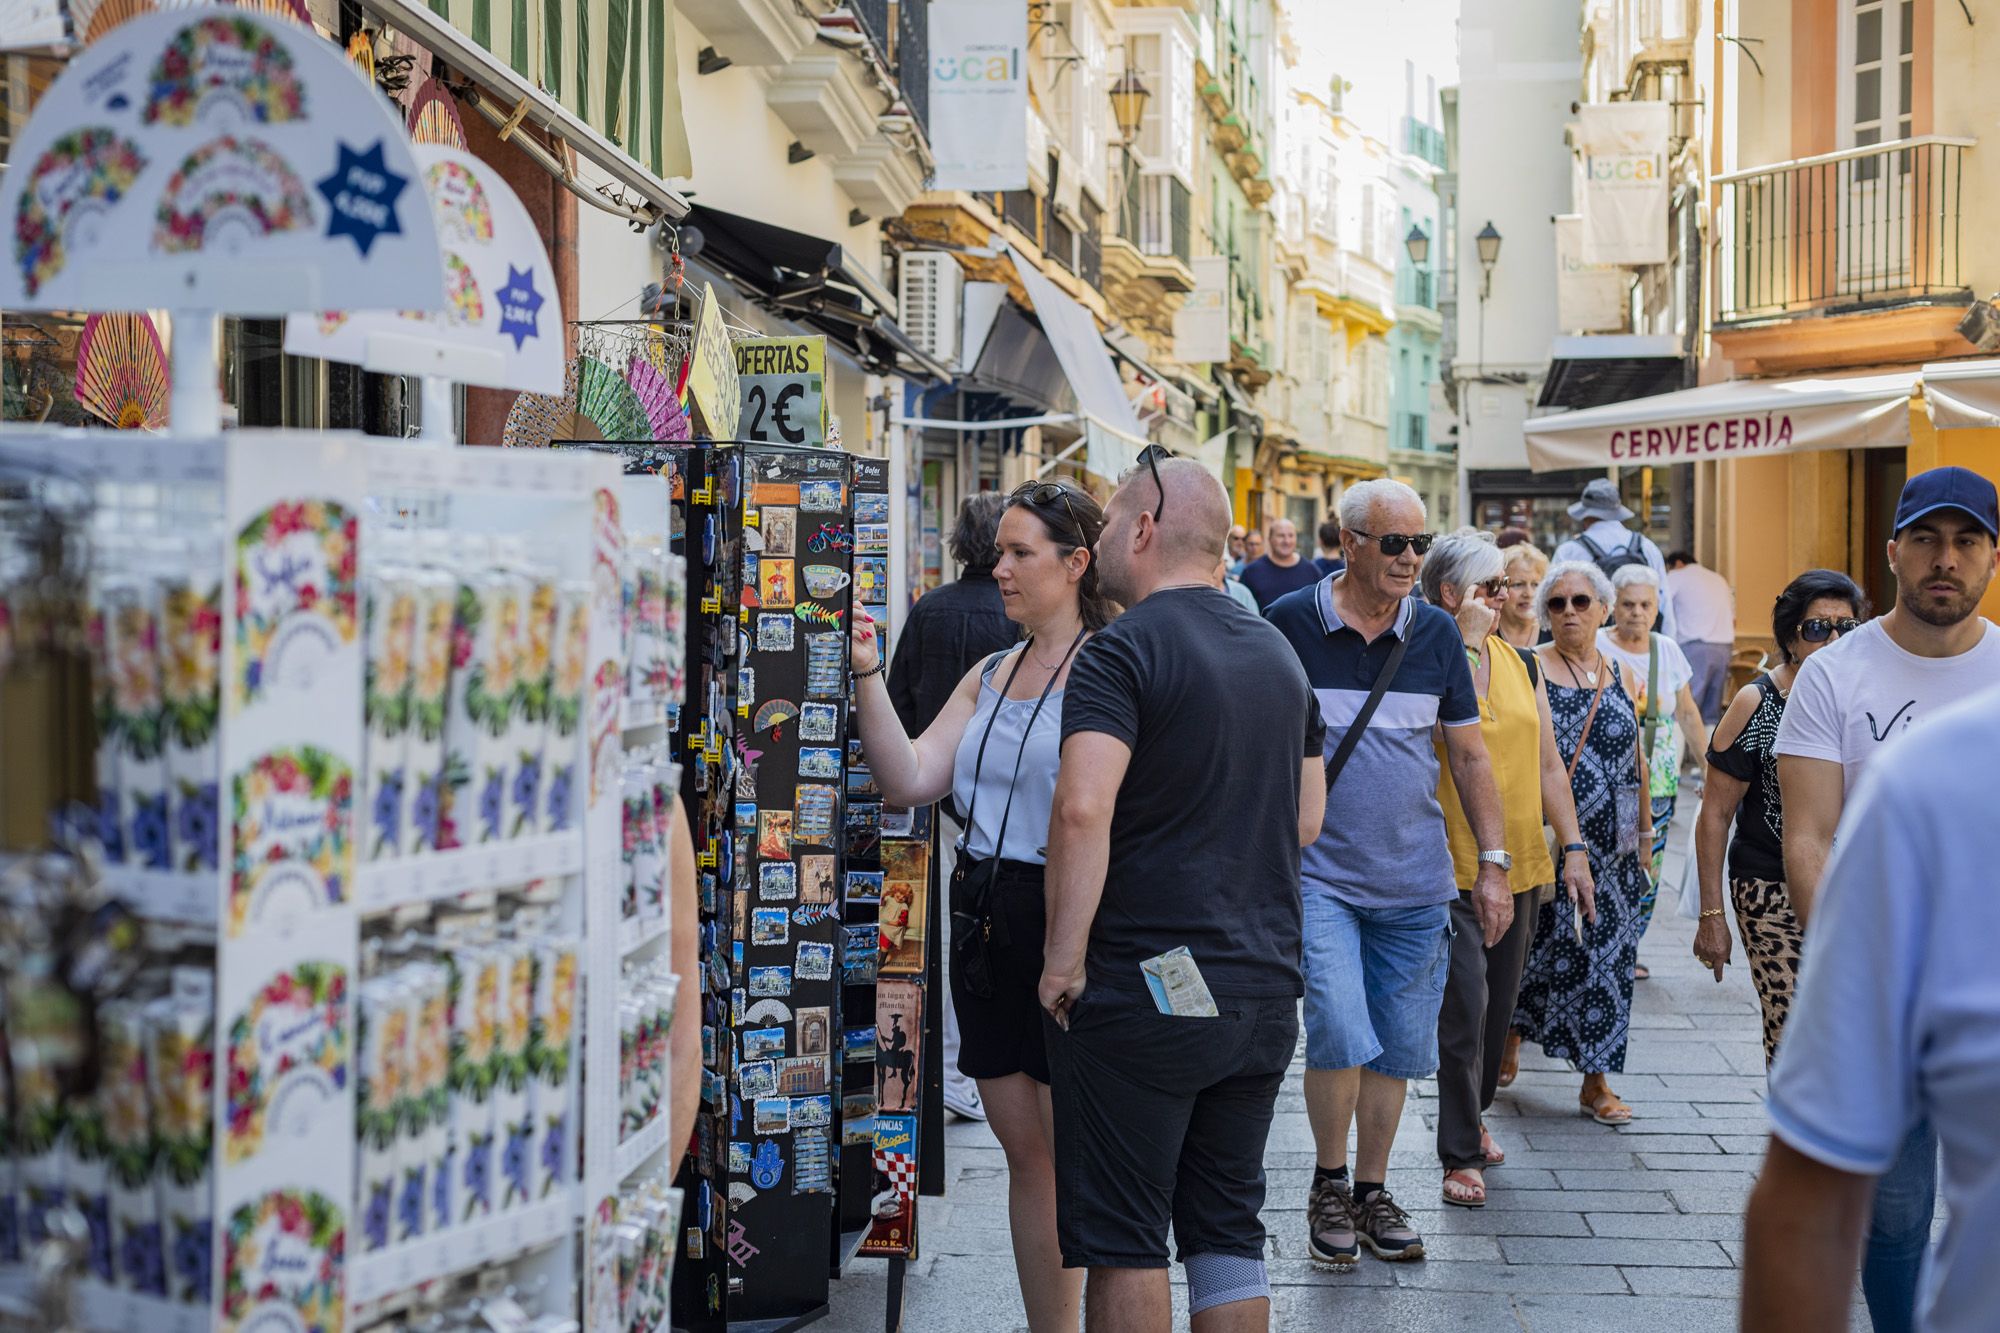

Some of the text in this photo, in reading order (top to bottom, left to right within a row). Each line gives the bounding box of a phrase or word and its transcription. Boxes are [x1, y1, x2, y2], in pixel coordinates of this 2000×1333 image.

[736, 345, 810, 375] OFERTAS
[748, 382, 806, 444] 2€
[1610, 411, 1794, 459] CERVECERÍA
[873, 1131, 911, 1151] Vespa
